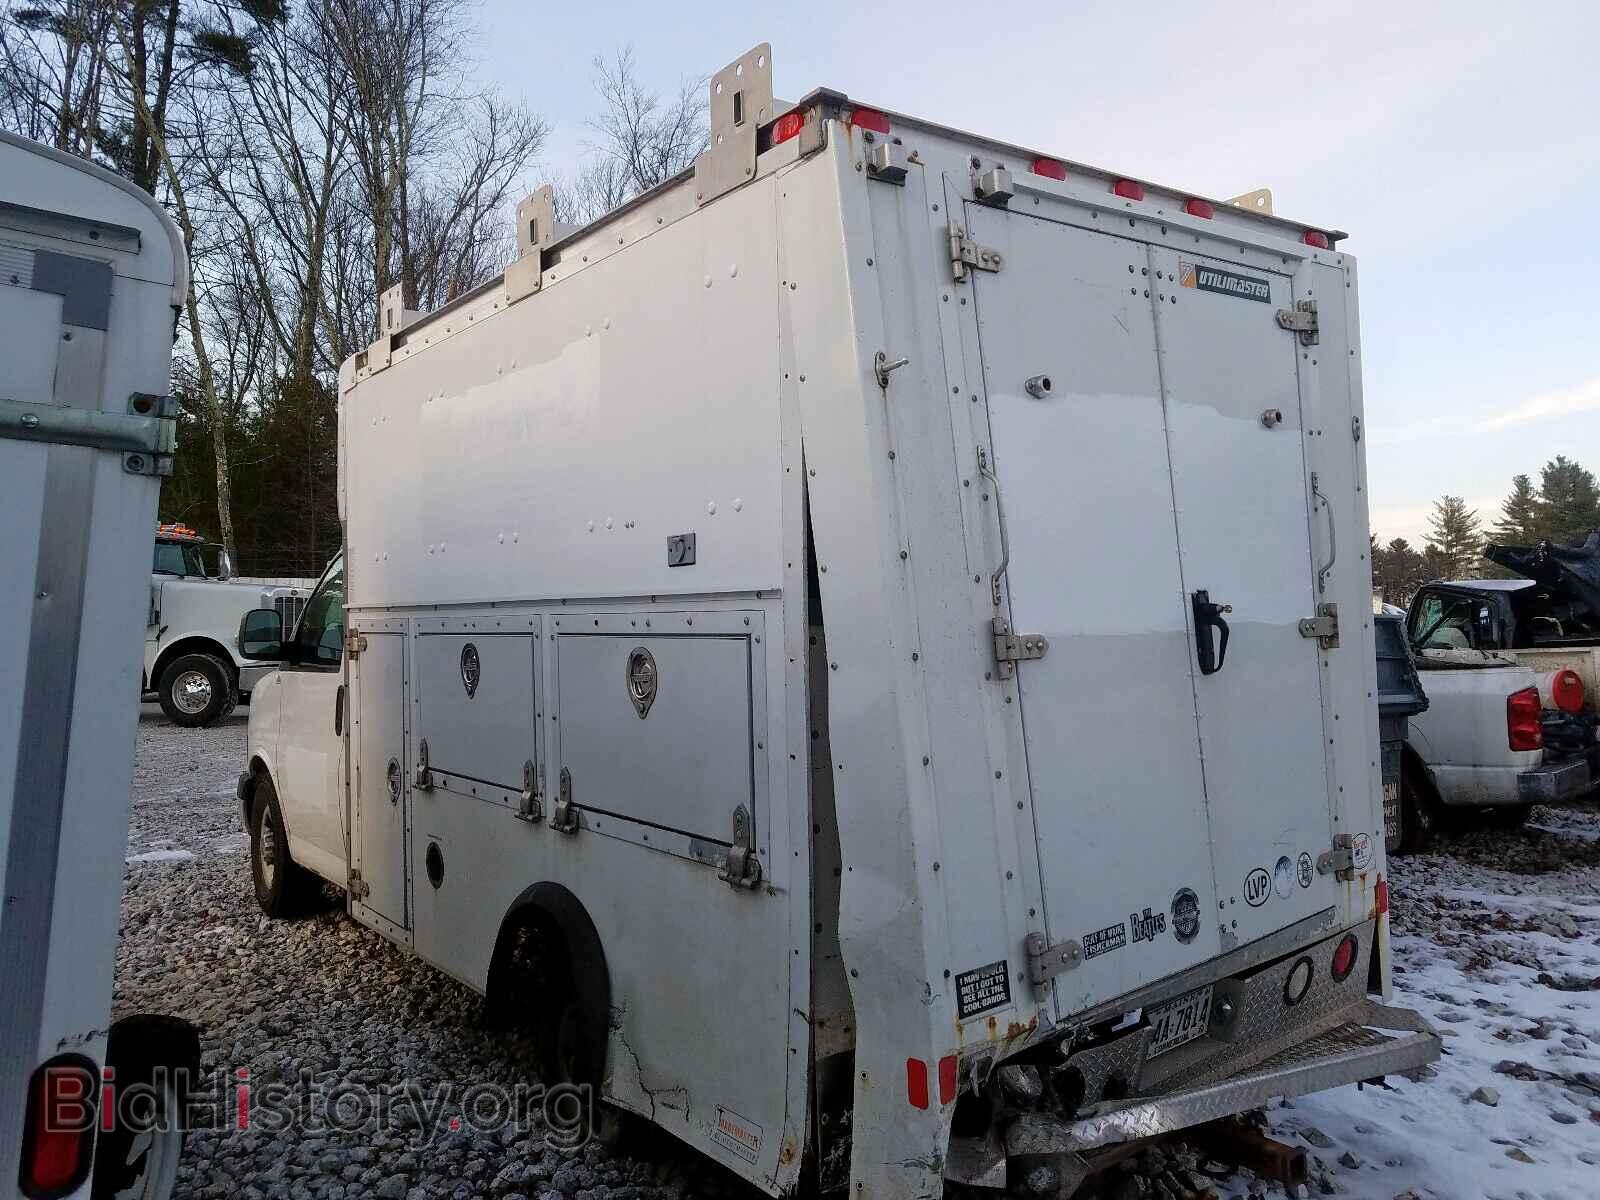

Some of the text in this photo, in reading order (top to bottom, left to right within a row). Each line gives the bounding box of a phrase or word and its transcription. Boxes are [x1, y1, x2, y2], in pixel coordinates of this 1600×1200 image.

[1198, 270, 1270, 298] UTILIMASTER
[1247, 874, 1268, 900] LVP
[1084, 935, 1126, 955] FISHERMAN
[961, 984, 975, 996] BUT
[980, 977, 994, 989] GOT
[994, 974, 1004, 984] TO
[963, 983, 1004, 1004] SEE ALL THE
